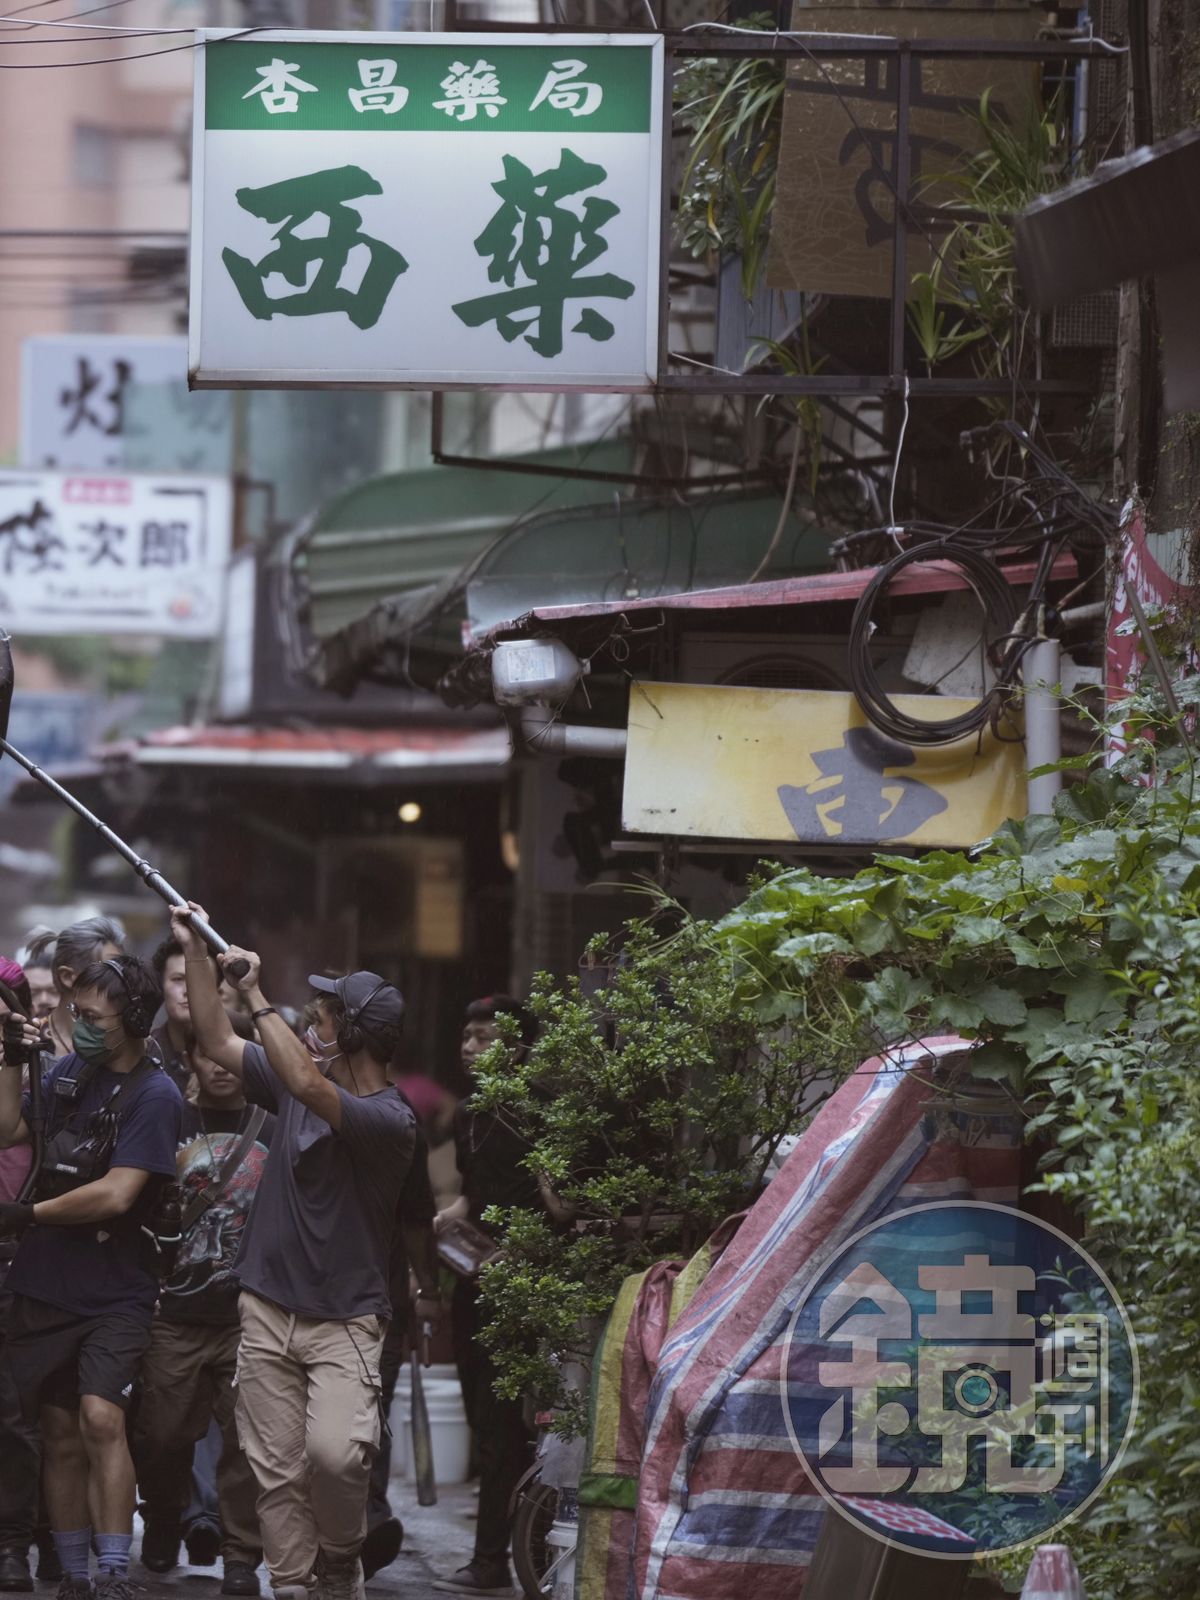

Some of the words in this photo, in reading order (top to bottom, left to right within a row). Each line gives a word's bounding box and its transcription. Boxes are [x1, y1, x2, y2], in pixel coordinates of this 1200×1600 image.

[242, 57, 604, 121] 杏昌藥局
[221, 147, 636, 358] 西藥
